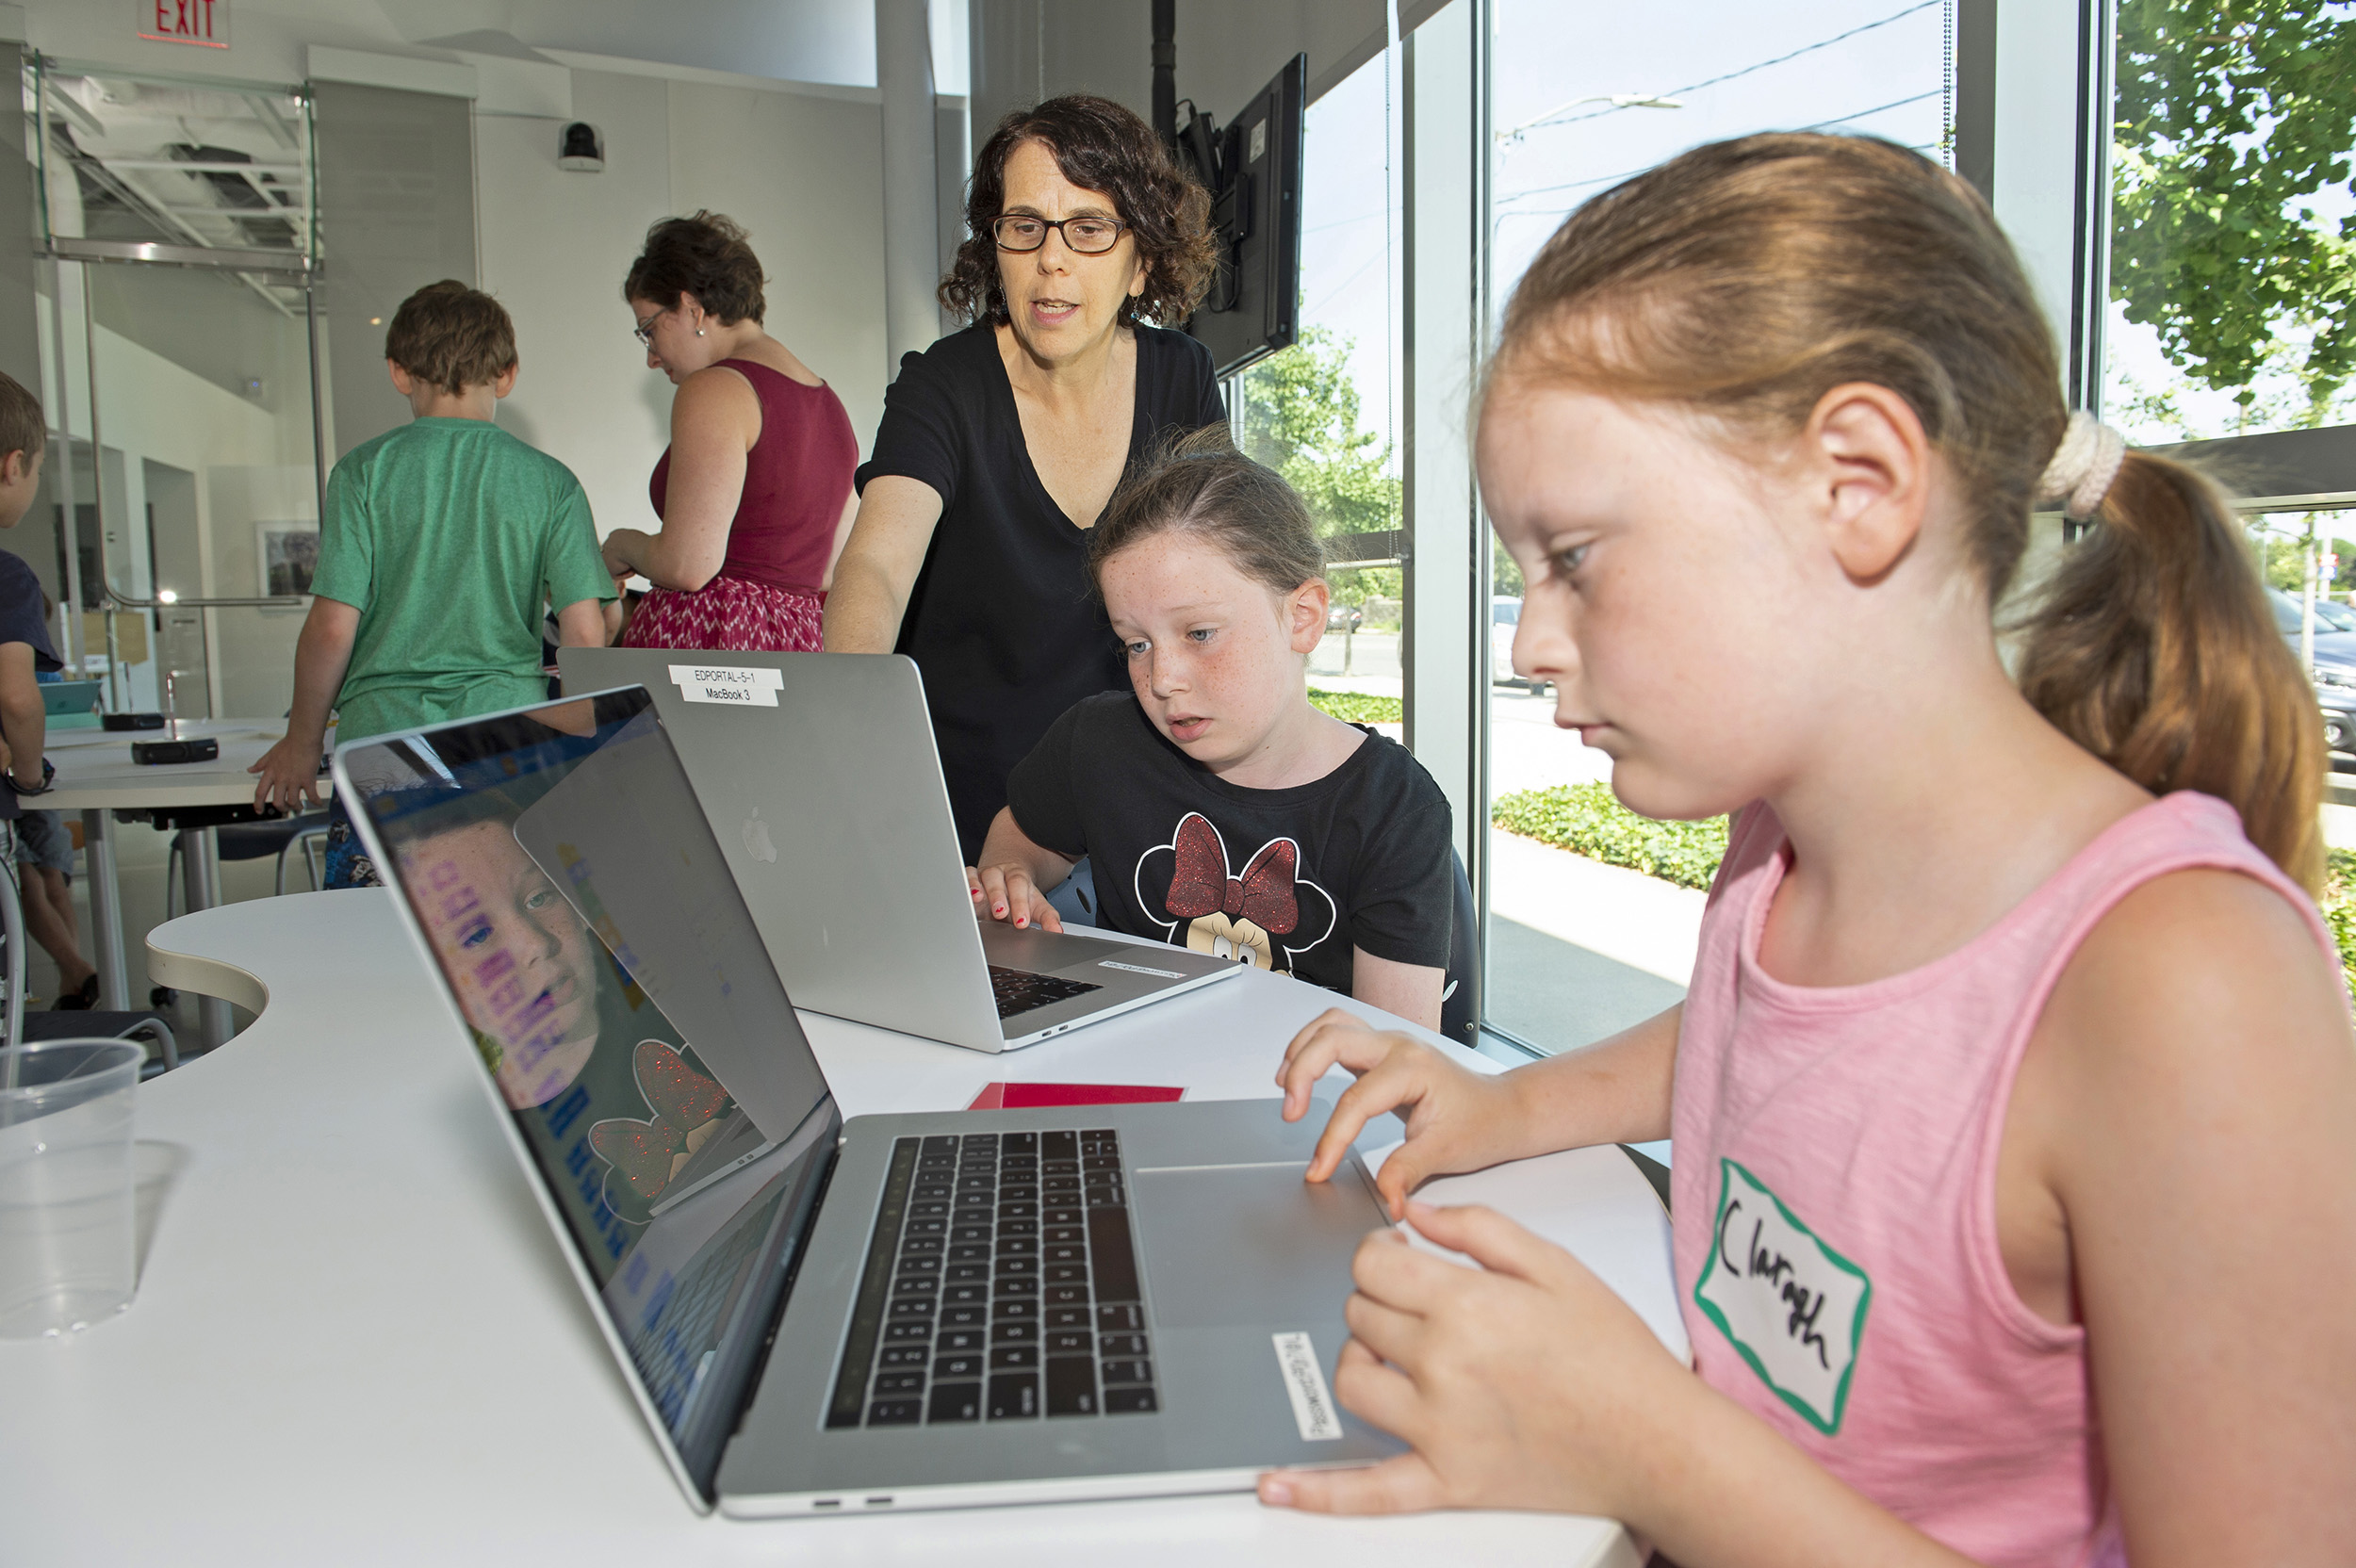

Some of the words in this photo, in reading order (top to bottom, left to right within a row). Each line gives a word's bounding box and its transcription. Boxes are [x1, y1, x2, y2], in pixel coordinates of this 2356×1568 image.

[155, 0, 215, 39] EXIT
[695, 670, 755, 683] EDPORTAL-5-1
[706, 688, 743, 700] MacBook
[744, 689, 751, 701] 3
